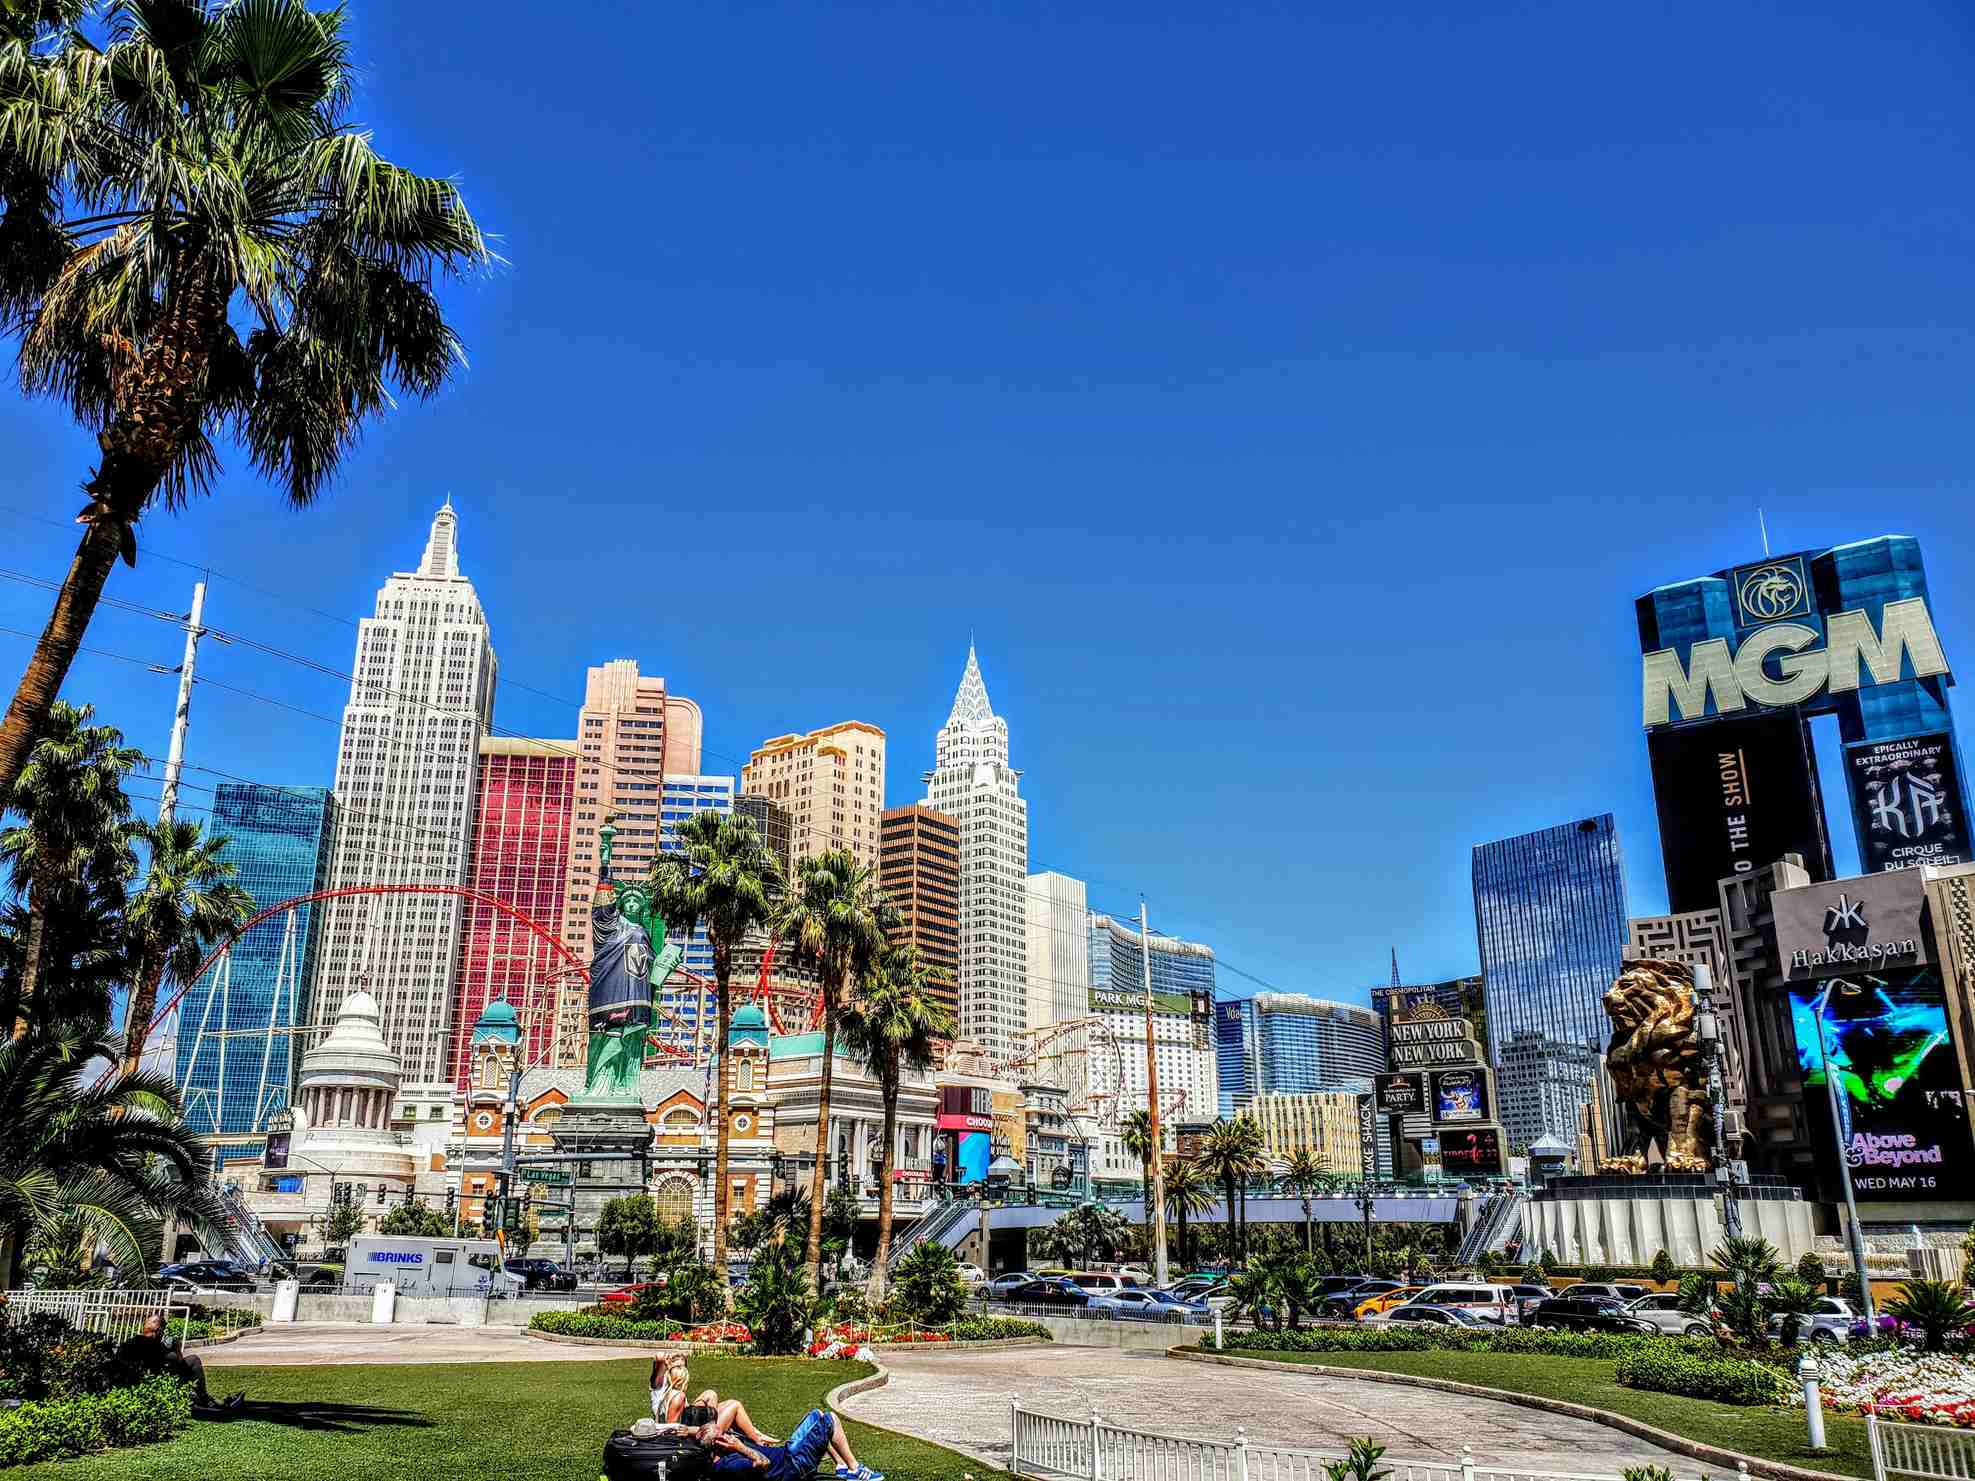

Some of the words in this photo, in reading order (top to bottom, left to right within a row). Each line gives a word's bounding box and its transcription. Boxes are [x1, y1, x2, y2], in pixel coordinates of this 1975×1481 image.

[1642, 597, 1950, 727] MGM
[1856, 745, 1942, 766] EXTRAORDINARY
[1873, 740, 1920, 754] EPICALLY
[1717, 752, 1743, 806] SHOW
[1727, 815, 1750, 852] THE
[1892, 842, 1944, 858] CIRQUE
[1885, 860, 1904, 872] DU
[1792, 939, 1916, 968] Hakkasan
[1094, 991, 1122, 1004] PARK
[1127, 993, 1153, 1006] MG
[1371, 989, 1385, 997] THE
[1392, 1023, 1424, 1041] NEW
[1424, 1021, 1464, 1039] YORK
[1394, 1045, 1425, 1062] NEW
[1426, 1042, 1465, 1060] YORK
[1385, 1092, 1414, 1103] PARTY
[1360, 1103, 1373, 1143] SHACK
[1852, 1132, 1917, 1149] Above
[1864, 1145, 1943, 1168] Beyond
[1854, 1177, 1887, 1190] WED
[1889, 1176, 1916, 1189] MAY
[1920, 1176, 1937, 1188] 16
[376, 1250, 424, 1264] BRINKS
